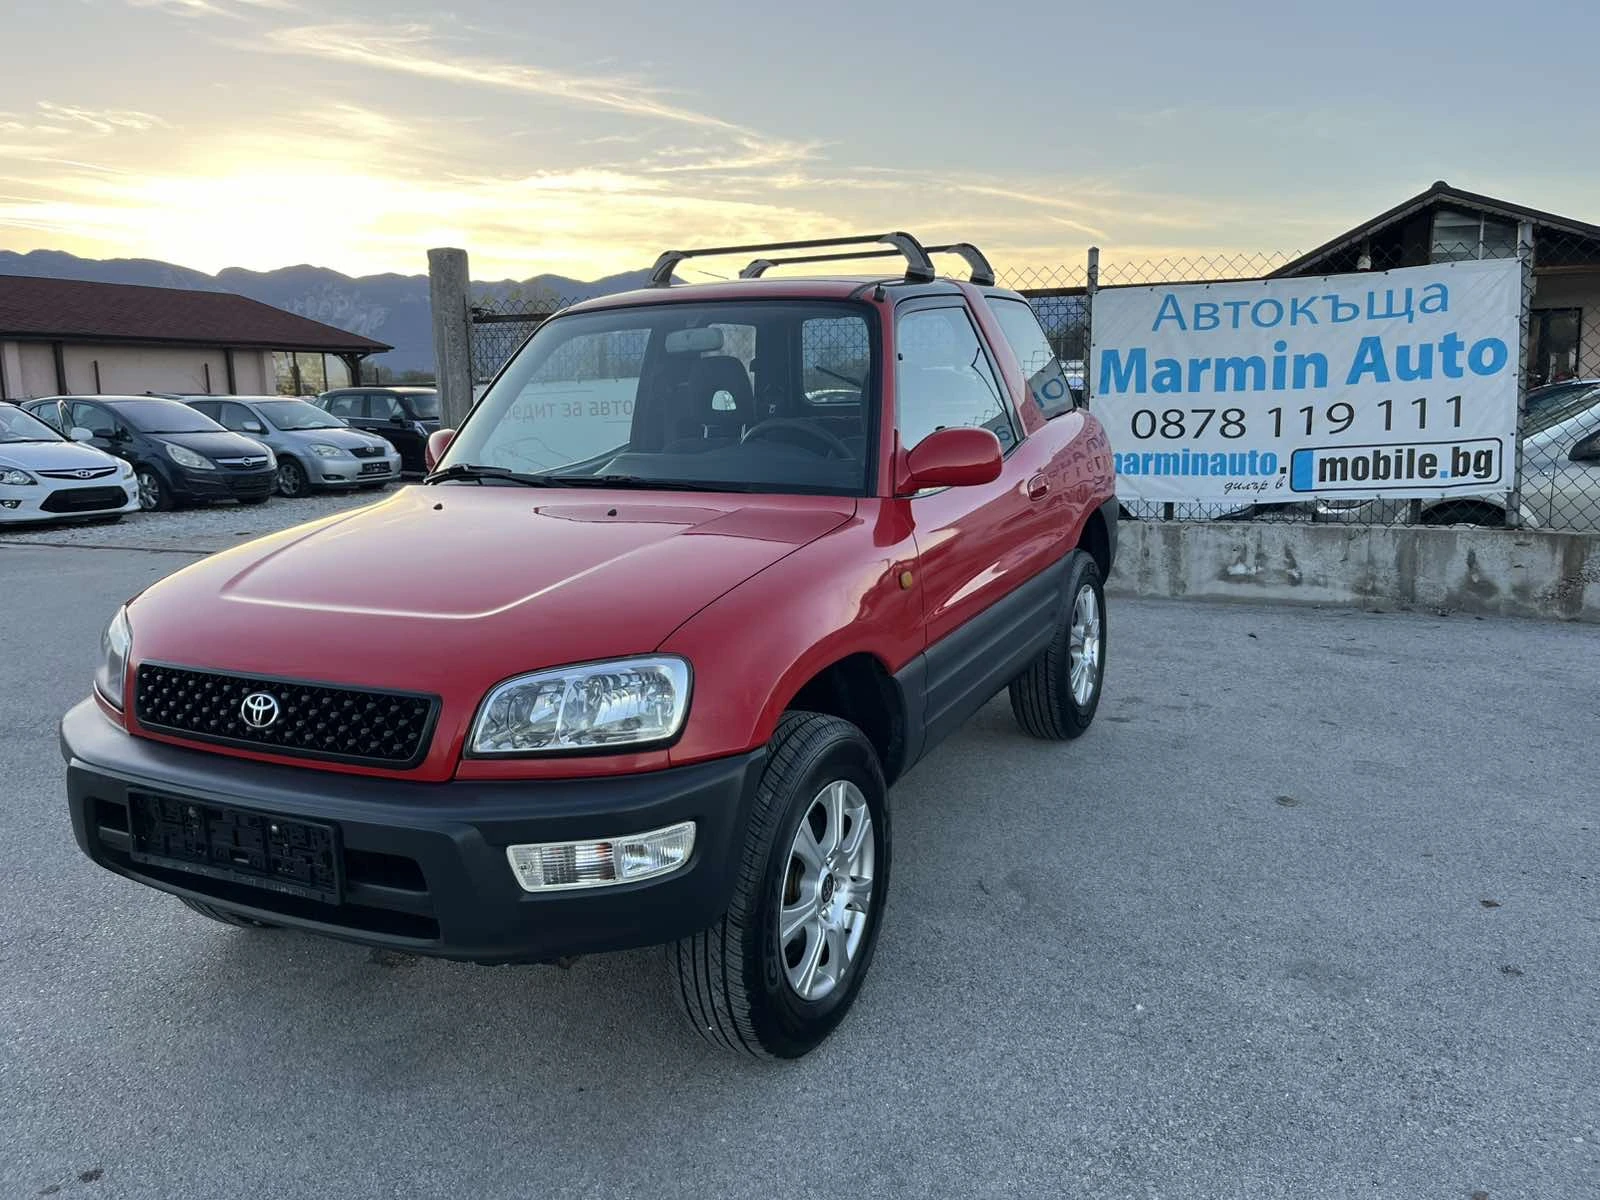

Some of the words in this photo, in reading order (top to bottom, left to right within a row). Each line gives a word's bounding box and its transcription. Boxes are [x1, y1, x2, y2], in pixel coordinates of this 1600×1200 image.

[1151, 281, 1450, 332] Автокъща
[1099, 340, 1329, 395] Marmin
[1345, 331, 1508, 385] Auto
[505, 402, 557, 423] едит
[1130, 407, 1247, 440] 0878
[1267, 402, 1355, 438] 119
[1376, 395, 1463, 431] 111
[1317, 447, 1494, 483] mobile.bg
